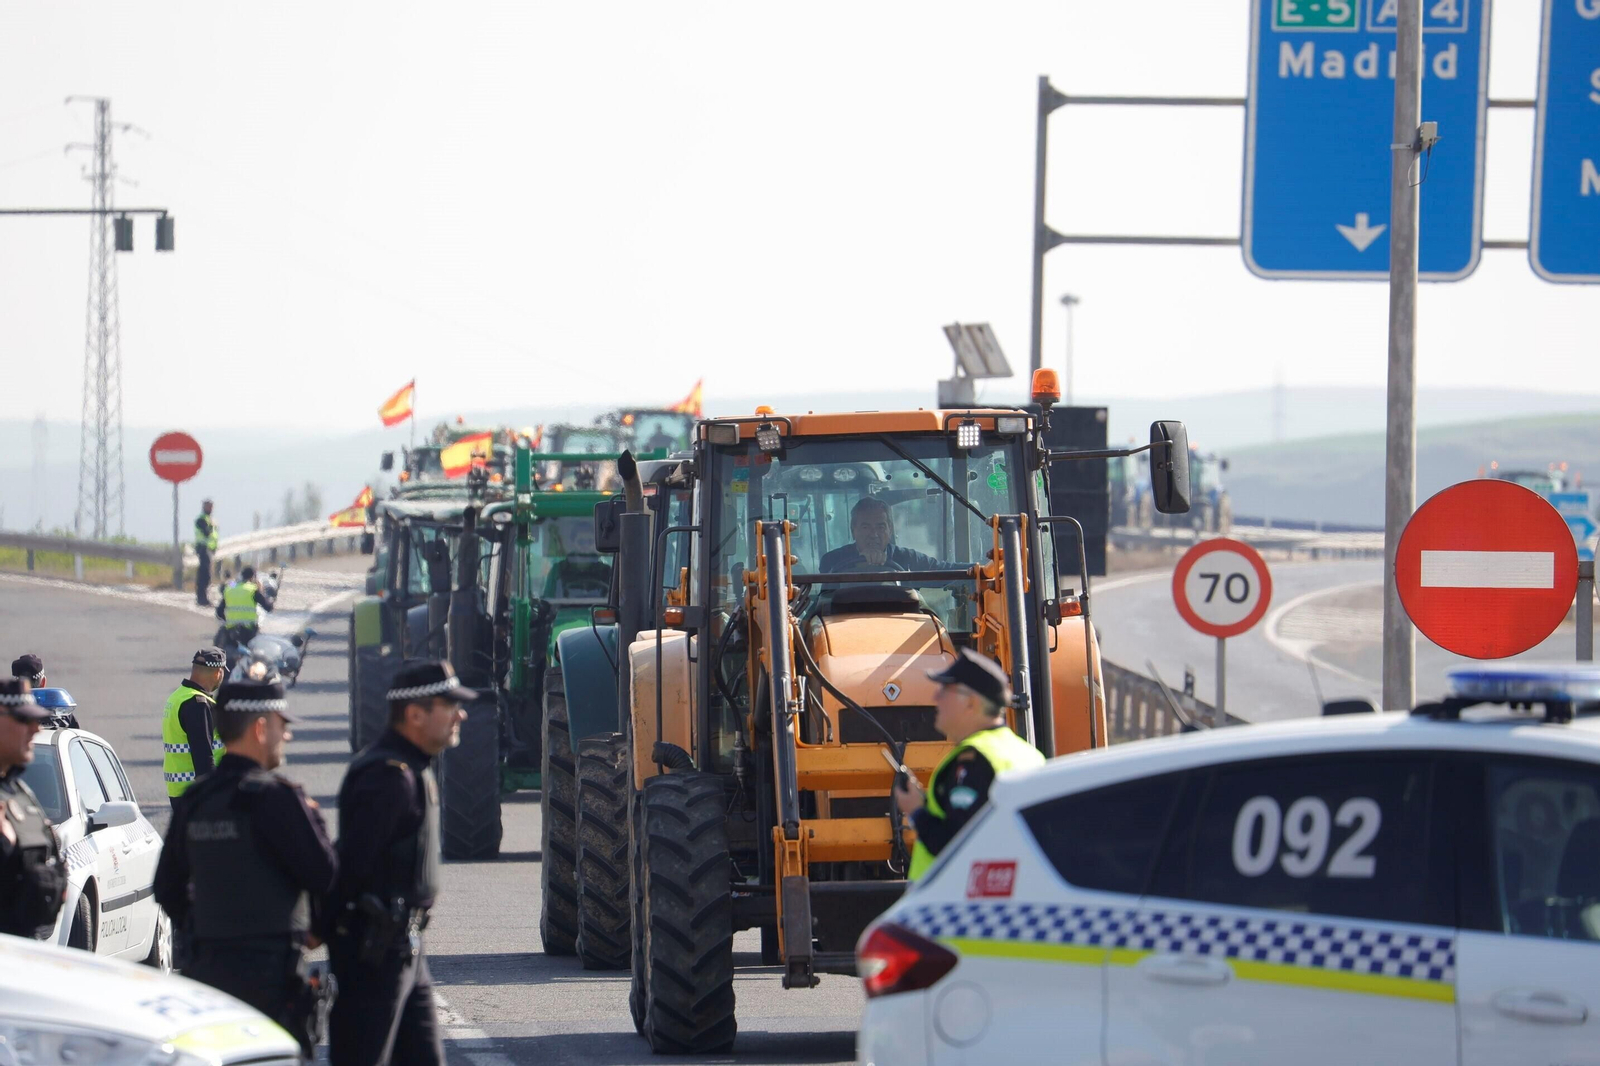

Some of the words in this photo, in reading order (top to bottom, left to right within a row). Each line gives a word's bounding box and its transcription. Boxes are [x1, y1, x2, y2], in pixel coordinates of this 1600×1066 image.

[1376, 0, 1459, 24] A4
[1199, 572, 1250, 604] 70
[1231, 795, 1382, 878] 092
